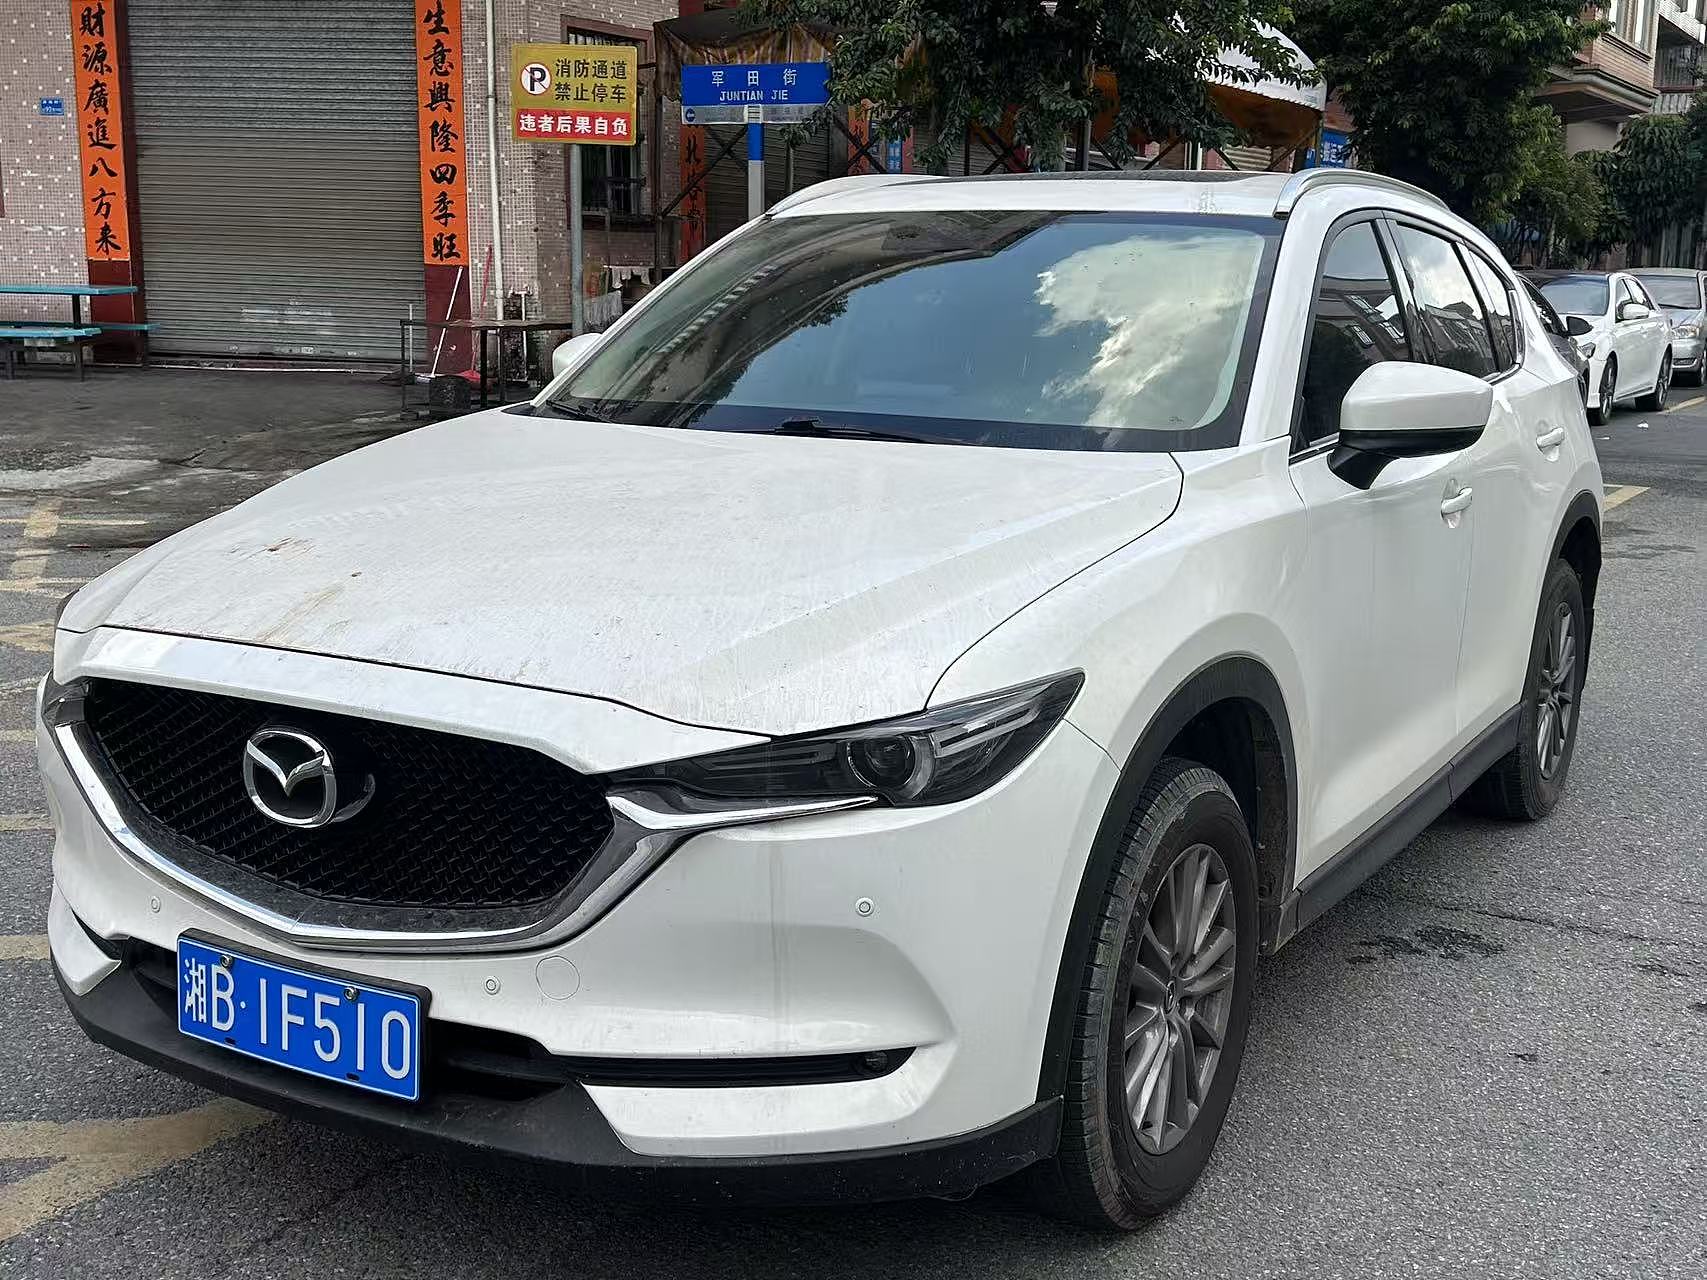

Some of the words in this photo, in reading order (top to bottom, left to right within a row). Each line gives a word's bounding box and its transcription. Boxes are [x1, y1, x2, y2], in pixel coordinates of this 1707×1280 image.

[555, 58, 628, 80] 消防通道
[711, 68, 798, 87] 军田街
[554, 81, 627, 104] 禁止停车
[719, 90, 764, 102] JUNTIAN
[771, 89, 789, 101] JIE
[423, 0, 461, 262] 生意興隆四季旺
[519, 113, 629, 136] 违者后果自负
